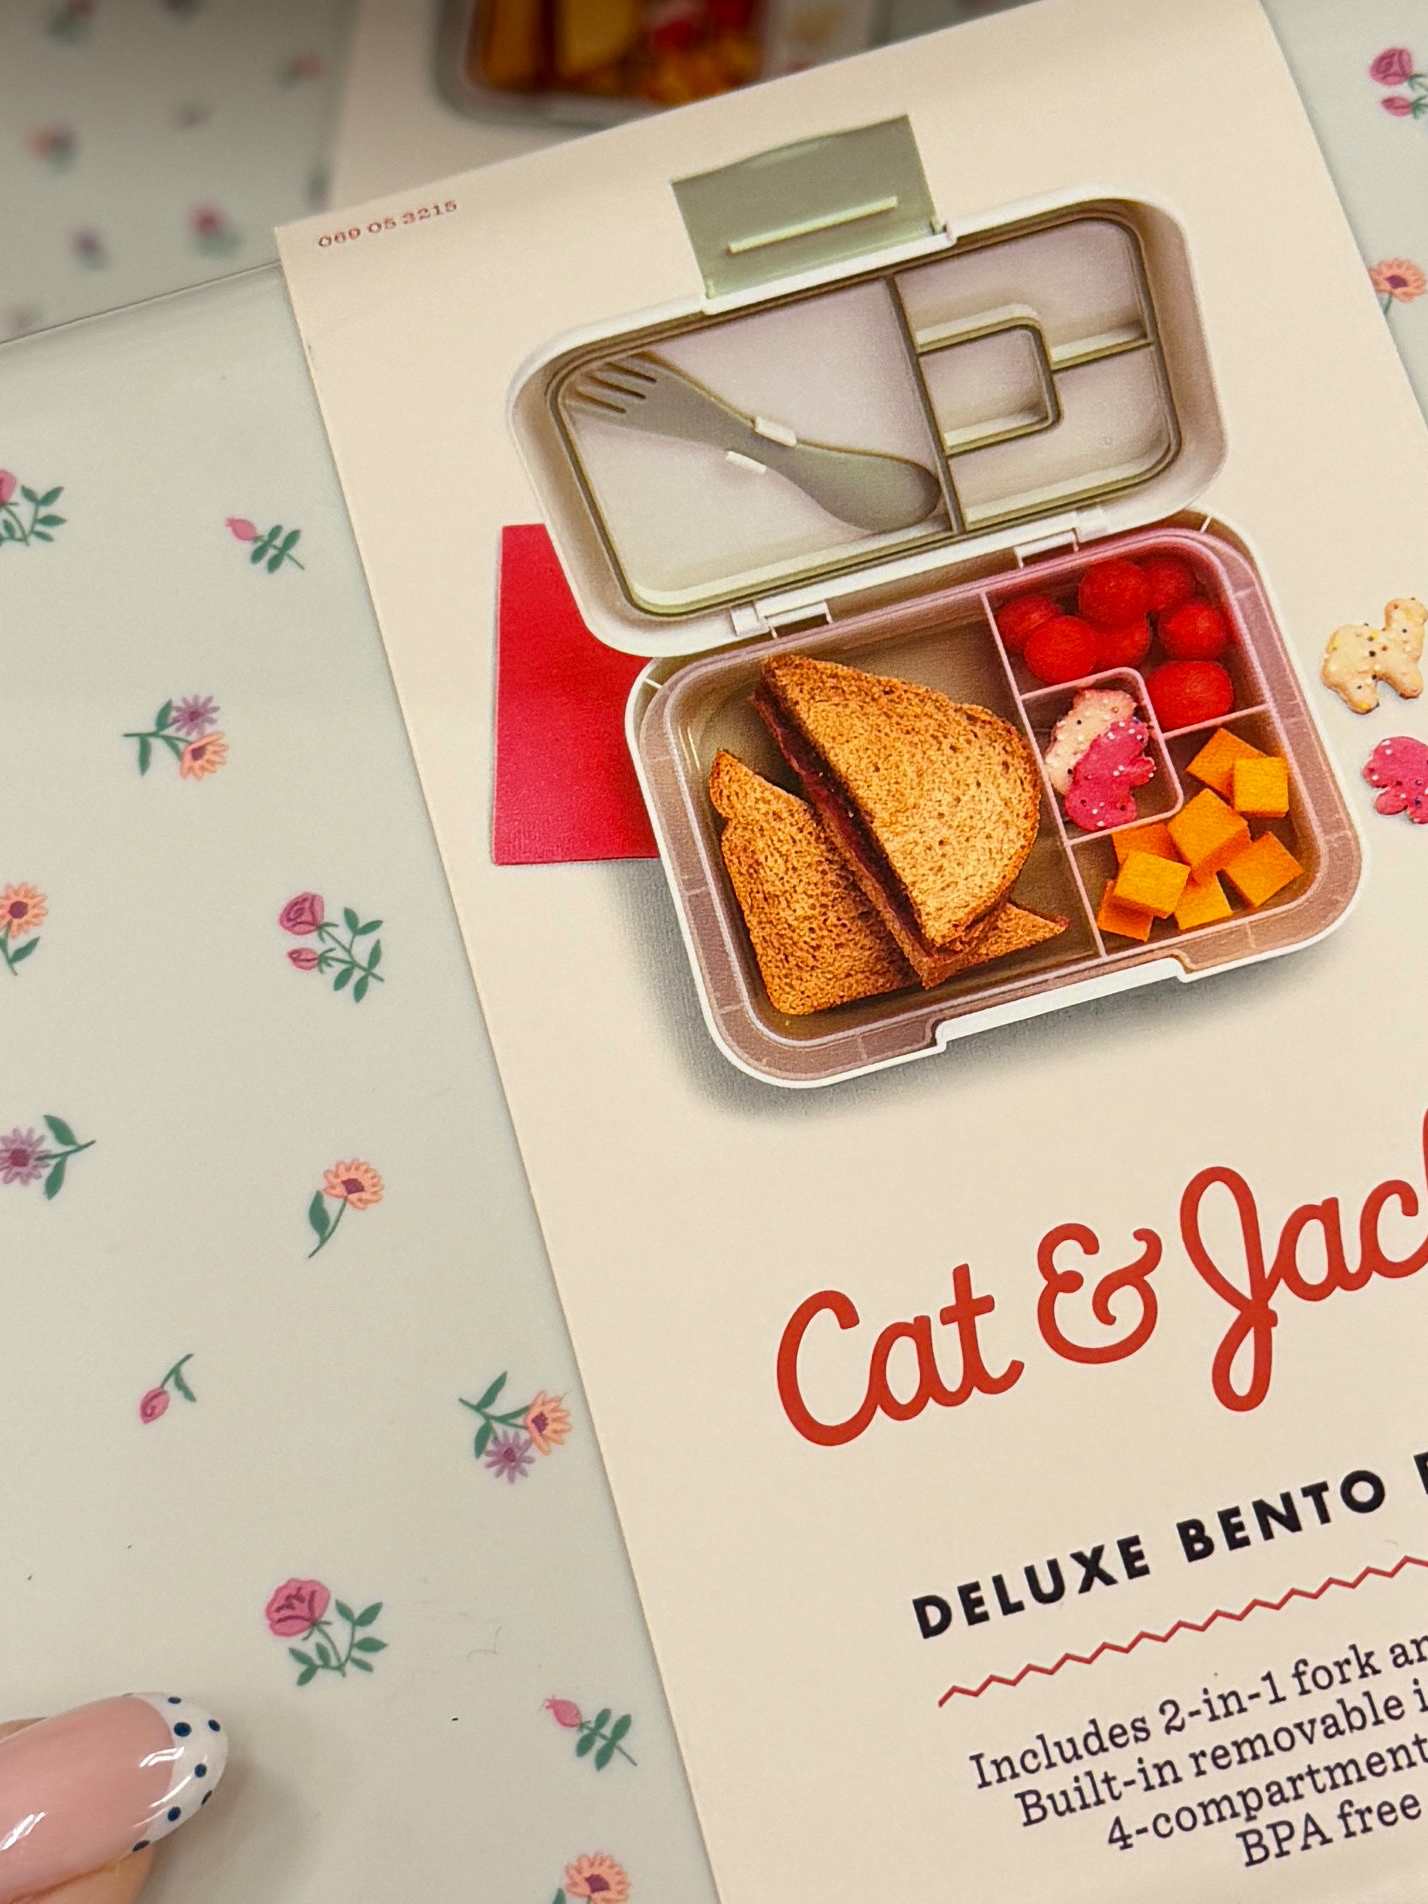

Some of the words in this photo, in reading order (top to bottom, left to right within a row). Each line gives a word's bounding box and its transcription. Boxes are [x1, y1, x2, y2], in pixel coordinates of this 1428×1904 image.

[367, 217, 397, 234] 05
[402, 199, 458, 225] 3215
[776, 1262, 1025, 1447] Cat
[1036, 1222, 1163, 1364] &
[912, 1534, 1151, 1639] DELUXE
[1176, 1469, 1386, 1564] BENTO
[969, 1716, 1152, 1789] Includes
[1158, 1669, 1288, 1736] 2-in-1
[1291, 1643, 1382, 1697] fork
[1014, 1756, 1182, 1828] Built-in
[1188, 1697, 1406, 1779] removable
[1236, 1813, 1333, 1867] BPA
[1337, 1791, 1423, 1841] free
